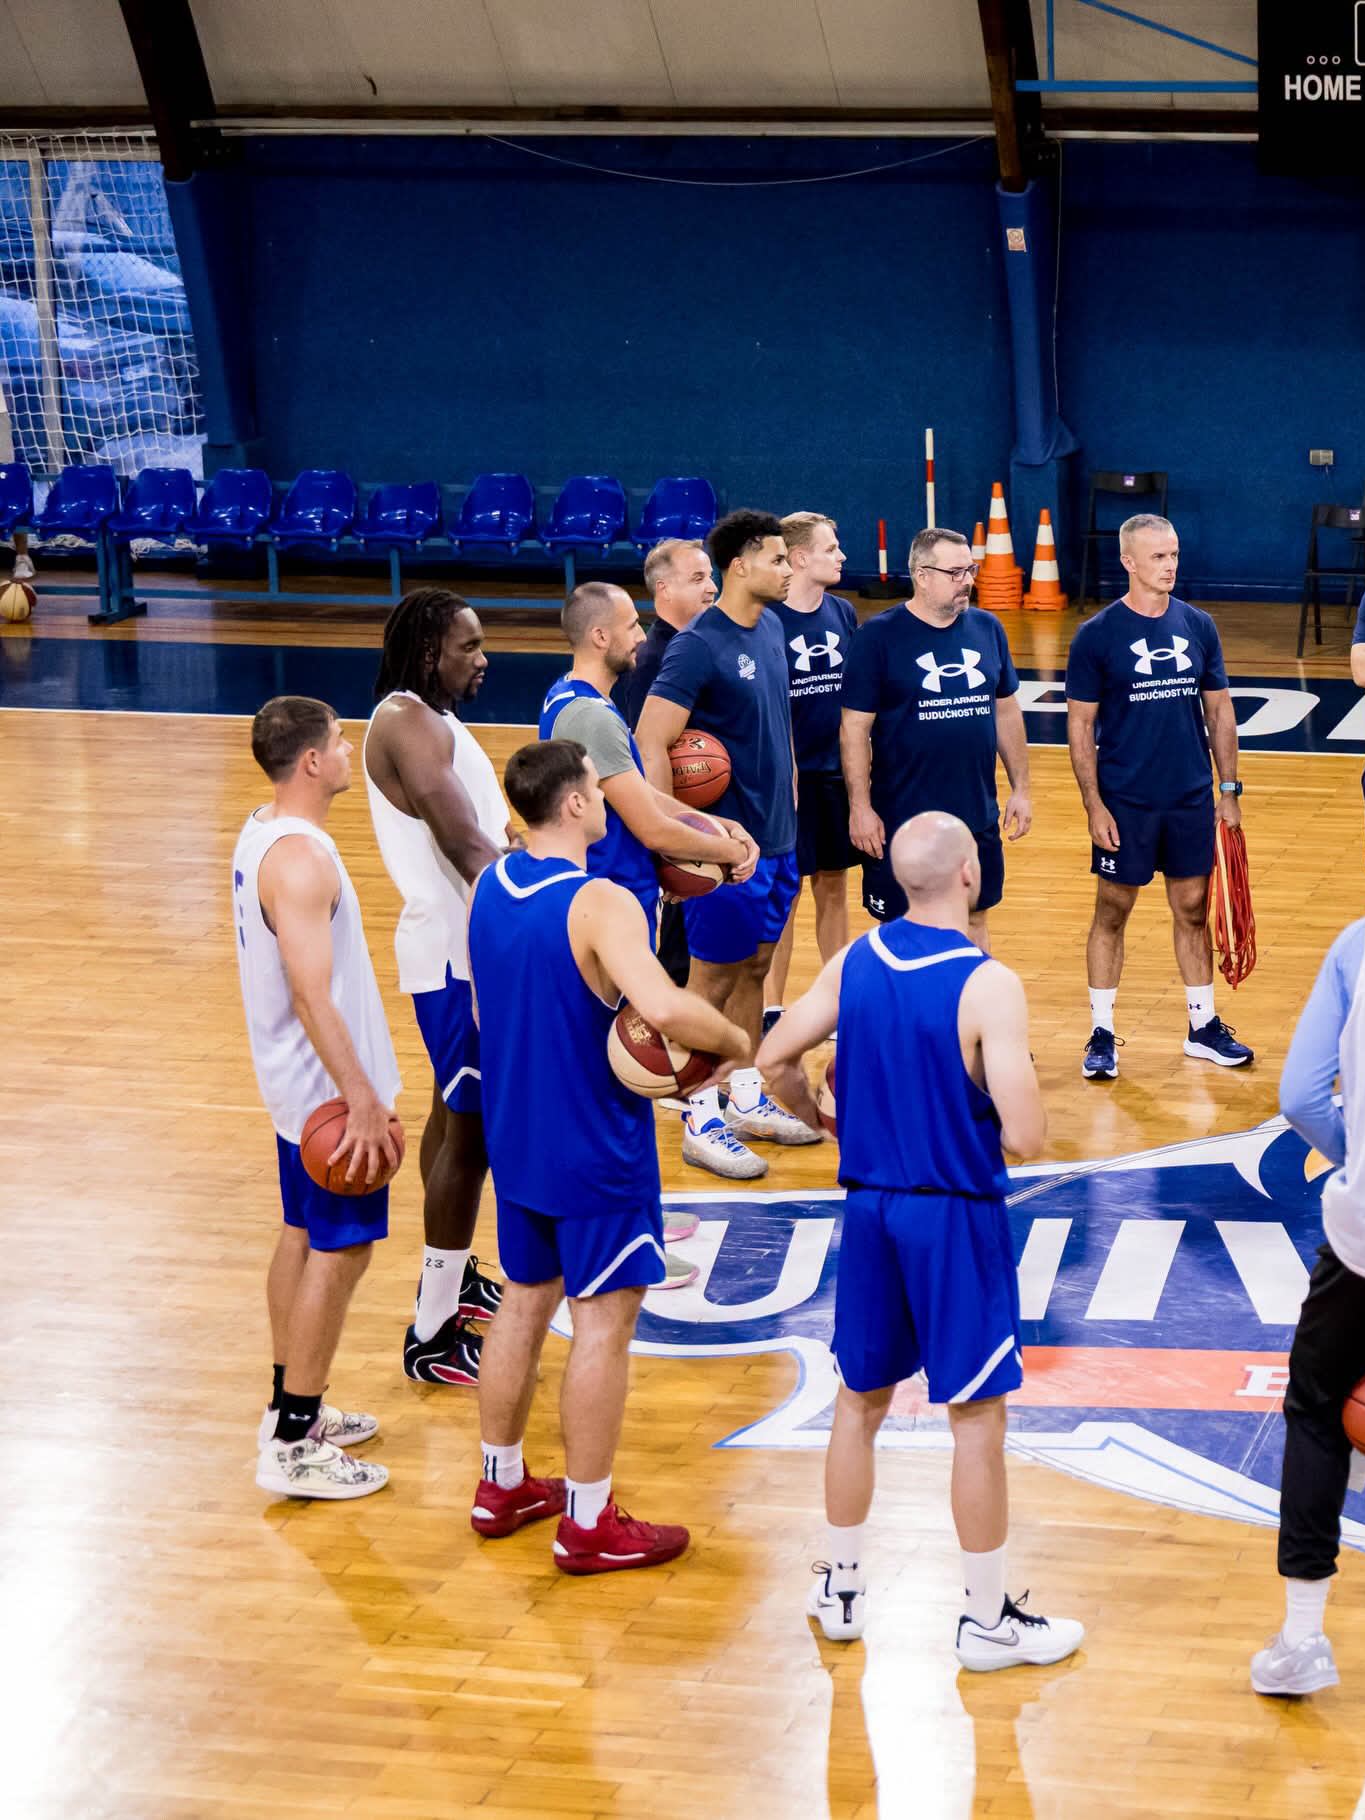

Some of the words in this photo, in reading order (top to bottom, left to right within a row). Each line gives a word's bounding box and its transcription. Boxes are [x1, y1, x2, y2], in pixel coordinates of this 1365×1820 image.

[1284, 74, 1362, 101] HOME
[1132, 680, 1162, 689] UNDER
[1162, 677, 1196, 686] ARMOUR
[918, 698, 952, 708] UNDER
[953, 694, 990, 705] ARMOUR
[1129, 688, 1181, 702] BUDUĆNOST
[918, 707, 974, 721] BUDUĆNOST
[974, 706, 991, 716] VOLI
[426, 1257, 444, 1268] 23
